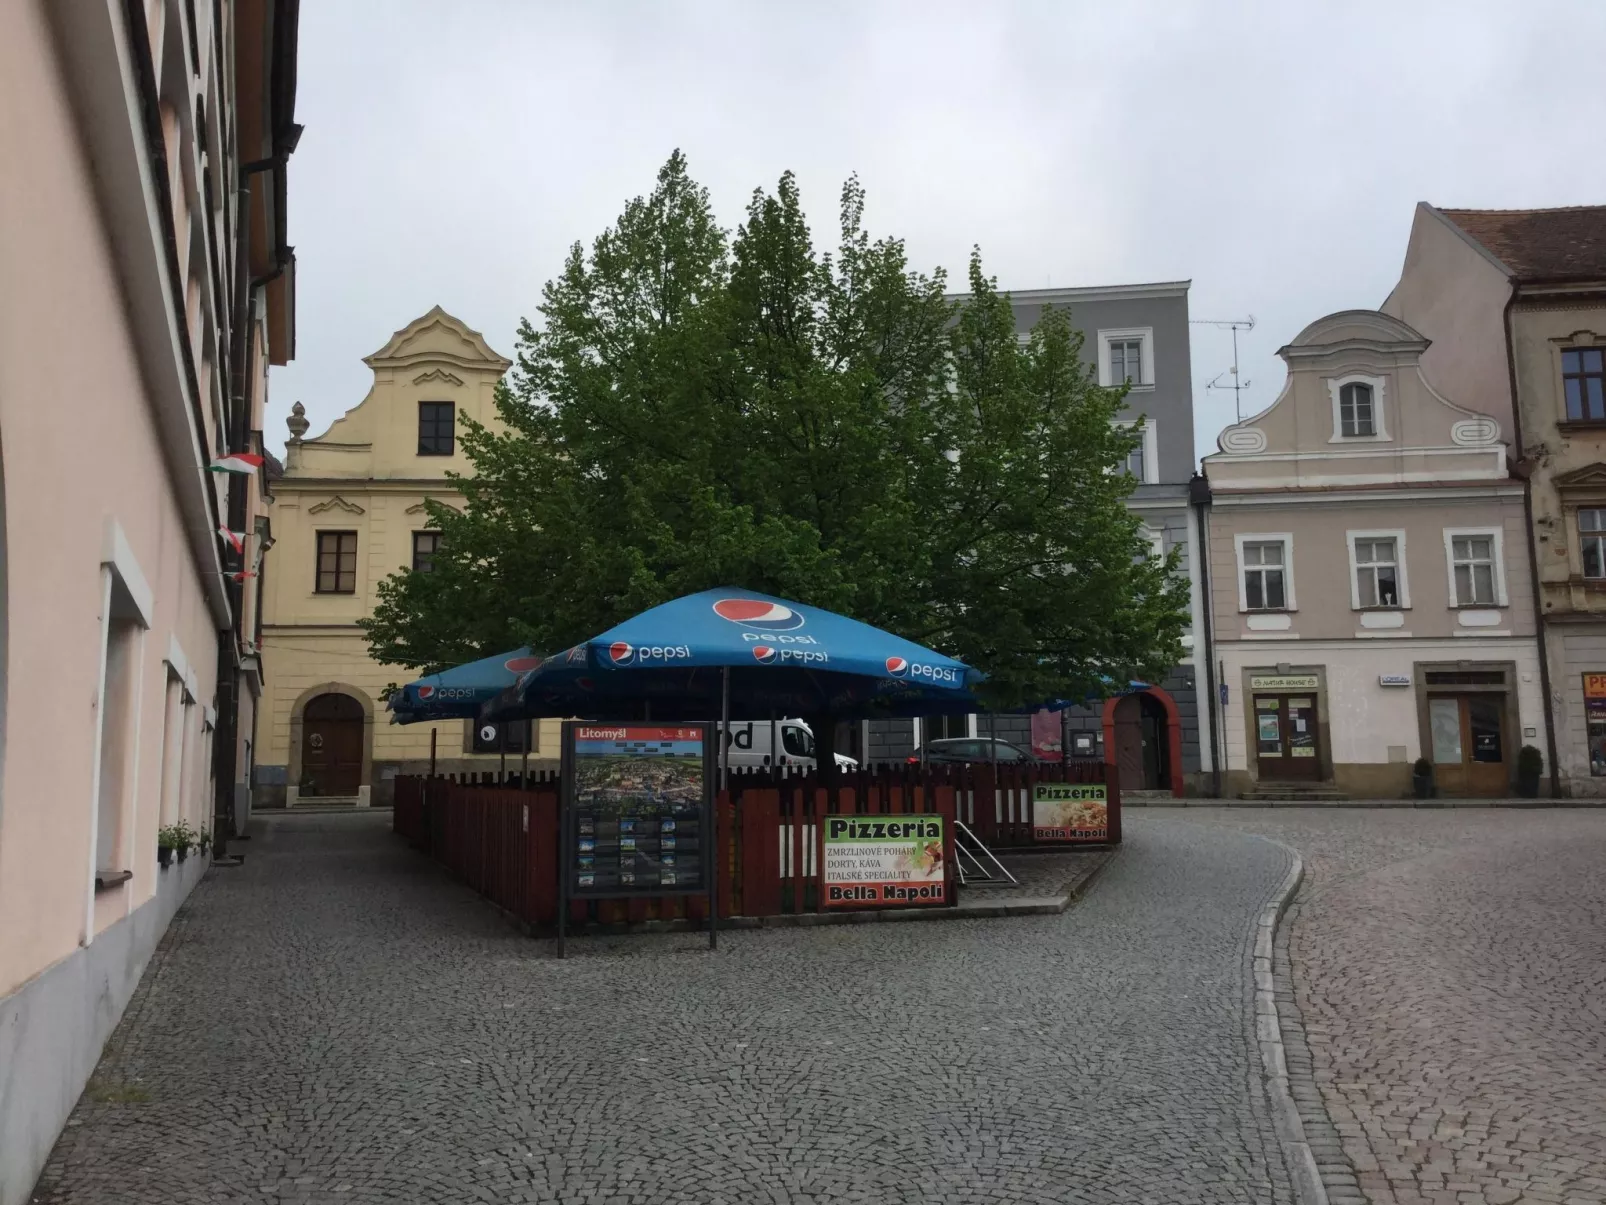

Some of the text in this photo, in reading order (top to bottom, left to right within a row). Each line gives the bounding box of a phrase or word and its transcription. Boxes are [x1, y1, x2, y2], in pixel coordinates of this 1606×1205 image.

[741, 632, 818, 645] pepsi
[638, 644, 690, 662] pepsi
[780, 649, 828, 662] pepsi
[911, 662, 956, 682] pepsi
[438, 687, 475, 700] pepsi
[579, 727, 627, 740] Litomyšl
[1036, 786, 1105, 799] Pizzeria
[830, 819, 940, 839] Pizzeria
[1036, 828, 1106, 838] Bella Napoli
[827, 846, 916, 856] ZMRZLINOVÉ POHÁRY
[827, 859, 881, 869] DORTY, KÁVA
[827, 871, 912, 880] ITALSKÉ SPECIALITY
[829, 884, 942, 902] Bella Napoli
